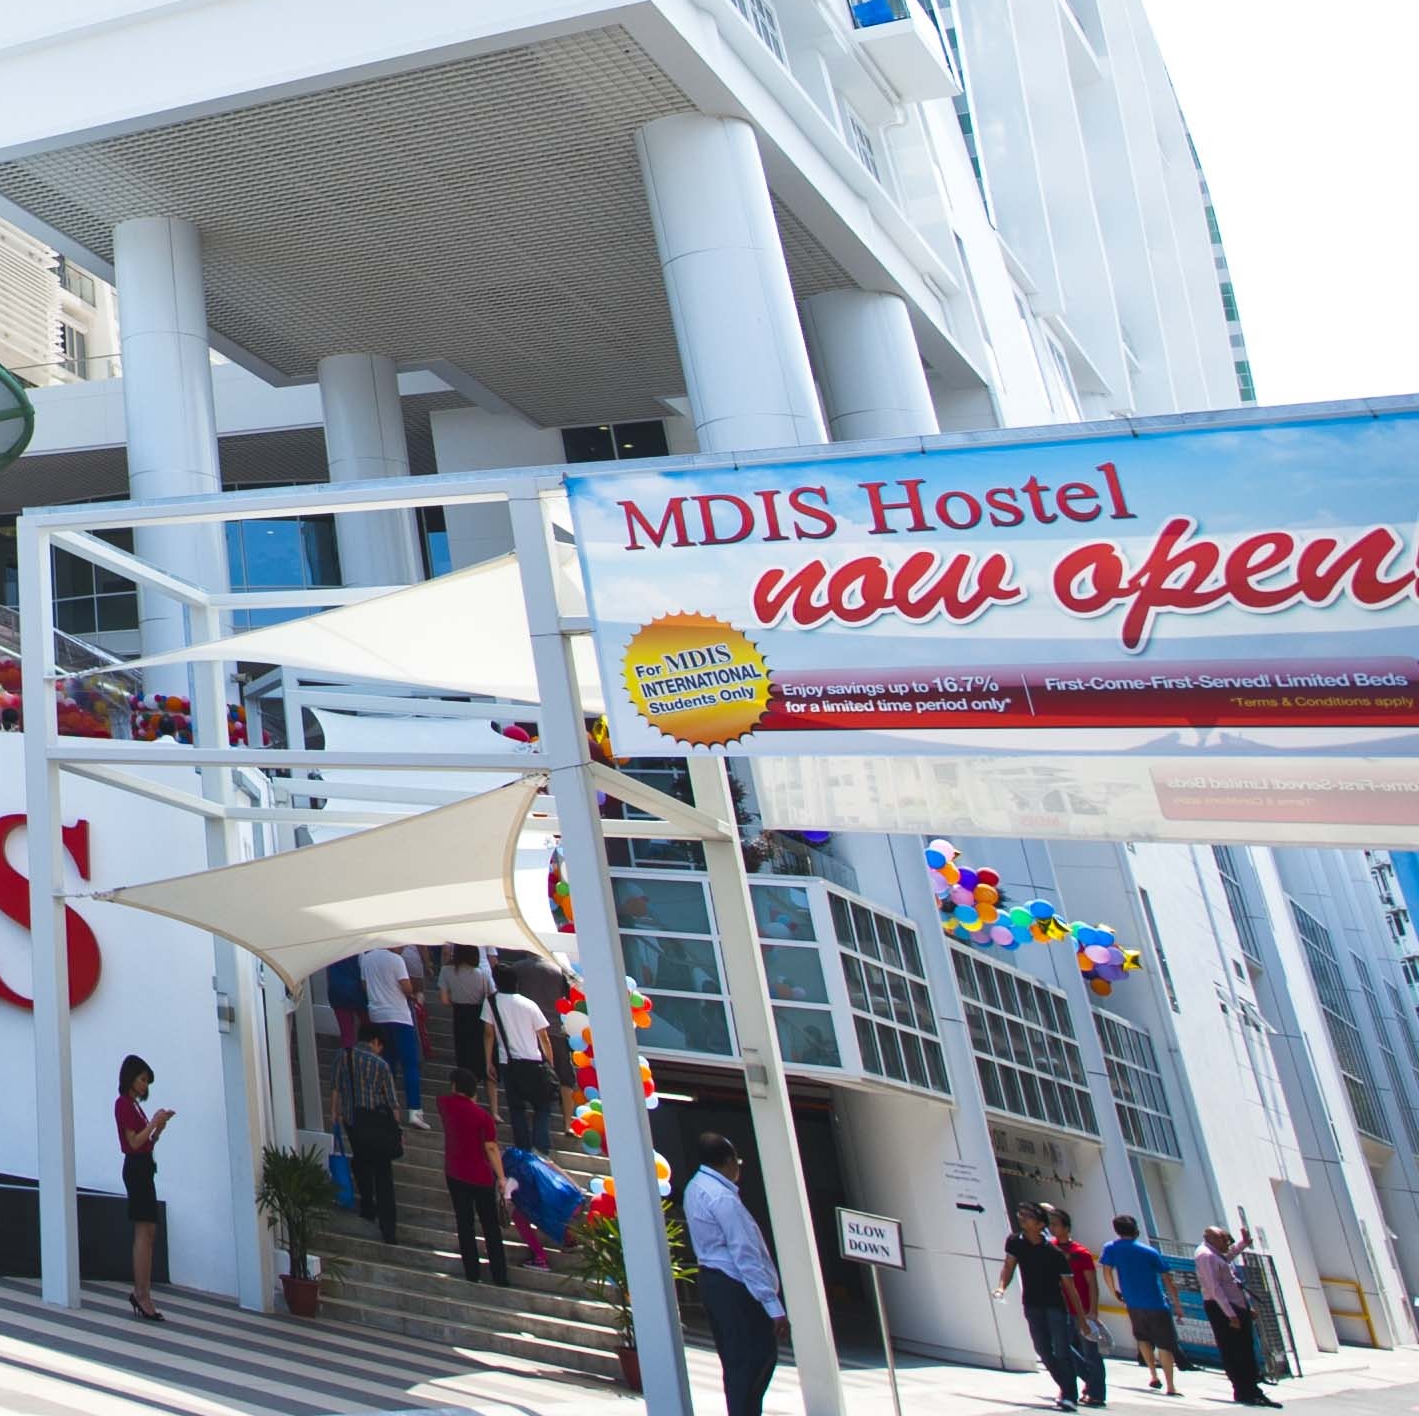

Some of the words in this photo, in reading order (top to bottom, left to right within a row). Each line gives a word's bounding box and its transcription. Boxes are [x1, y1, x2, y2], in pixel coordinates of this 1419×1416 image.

[617, 484, 838, 551] MDIS
[859, 462, 1137, 535] Hostel
[754, 548, 1023, 627] now
[1053, 517, 1419, 652] open
[635, 663, 661, 678] For
[664, 643, 732, 673] MDIS
[641, 663, 761, 698] INTERNATIONAL
[782, 682, 823, 697] Enjoy
[826, 681, 885, 697] savings
[888, 683, 908, 697] up
[911, 680, 929, 694] to
[932, 675, 999, 694] 16.7%
[1044, 673, 1271, 691] First-Come-First-Served!
[1277, 673, 1350, 688] Limited
[1355, 673, 1408, 687] Beds
[649, 693, 716, 715] Students
[720, 685, 754, 706] Only
[785, 700, 806, 713] for
[809, 703, 820, 713] a
[822, 699, 874, 713] limited
[877, 698, 914, 713] time
[917, 697, 969, 714] period
[1281, 696, 1293, 707] &
[1295, 695, 1371, 708] Conditions
[1374, 696, 1414, 710] apply
[848, 1222, 885, 1239] SLOW
[849, 1239, 891, 1257] DOWN
